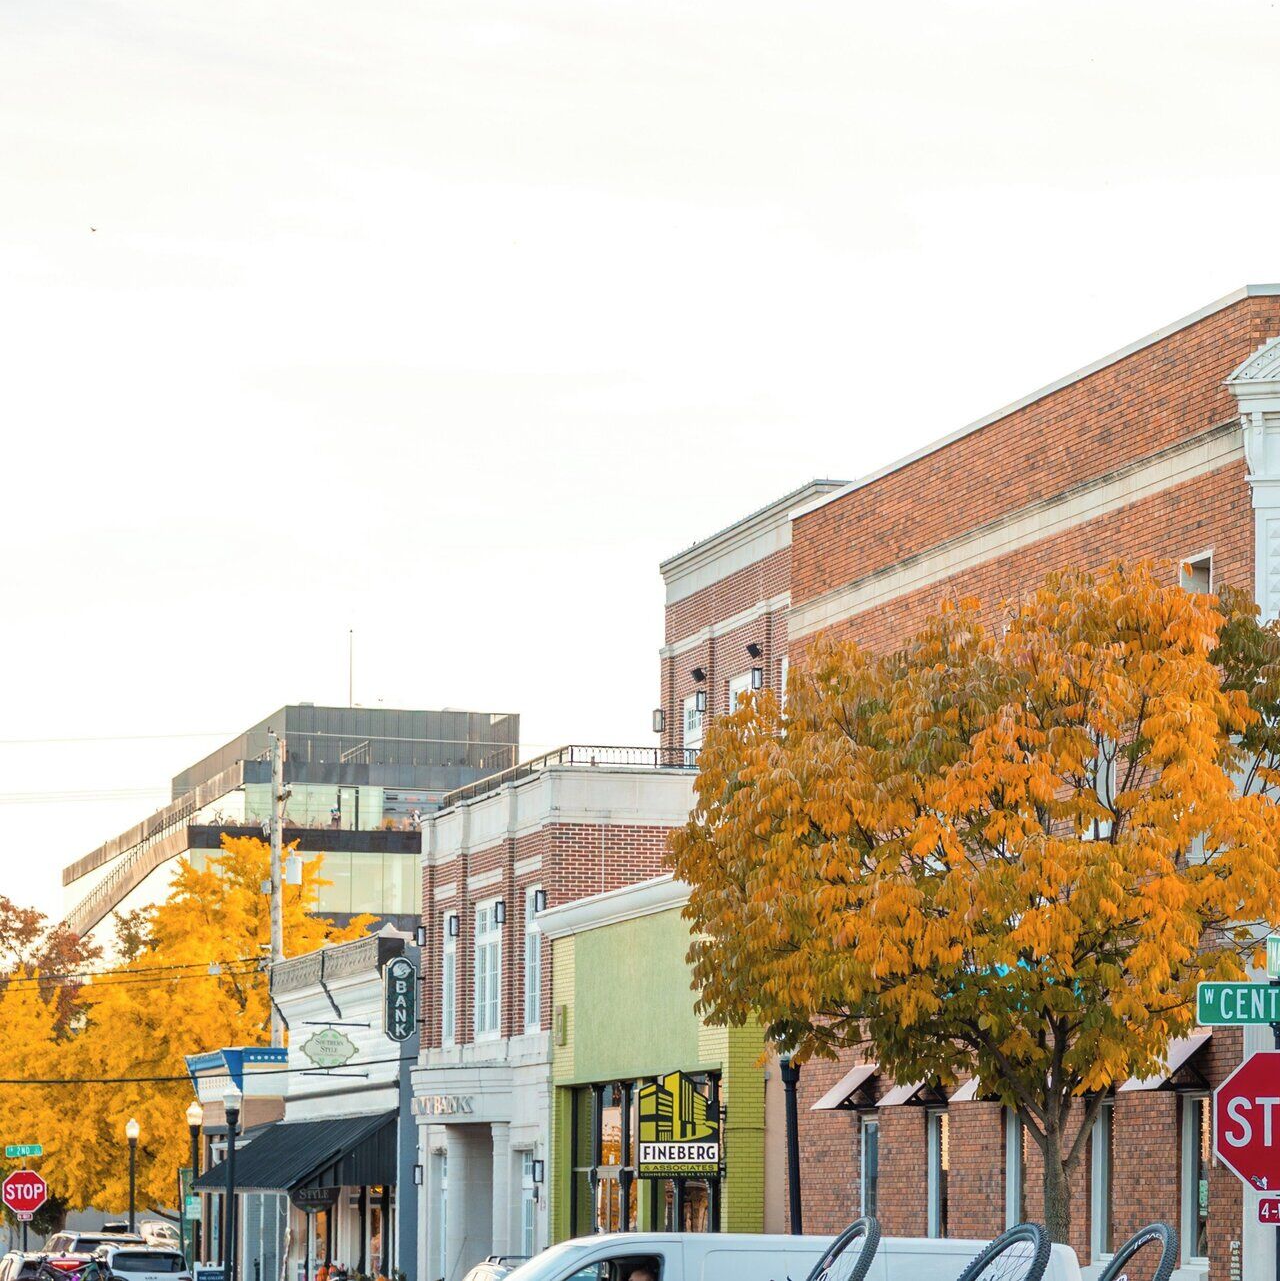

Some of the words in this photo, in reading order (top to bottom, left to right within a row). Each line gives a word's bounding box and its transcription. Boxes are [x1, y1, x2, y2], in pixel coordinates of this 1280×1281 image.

[1204, 988, 1215, 1004] W
[395, 980, 408, 1037] BANK
[643, 1145, 716, 1160] FINEBERG
[652, 1164, 715, 1172] ASSOCIATES
[5, 1183, 44, 1200] STOP
[299, 1189, 329, 1199] STYLE
